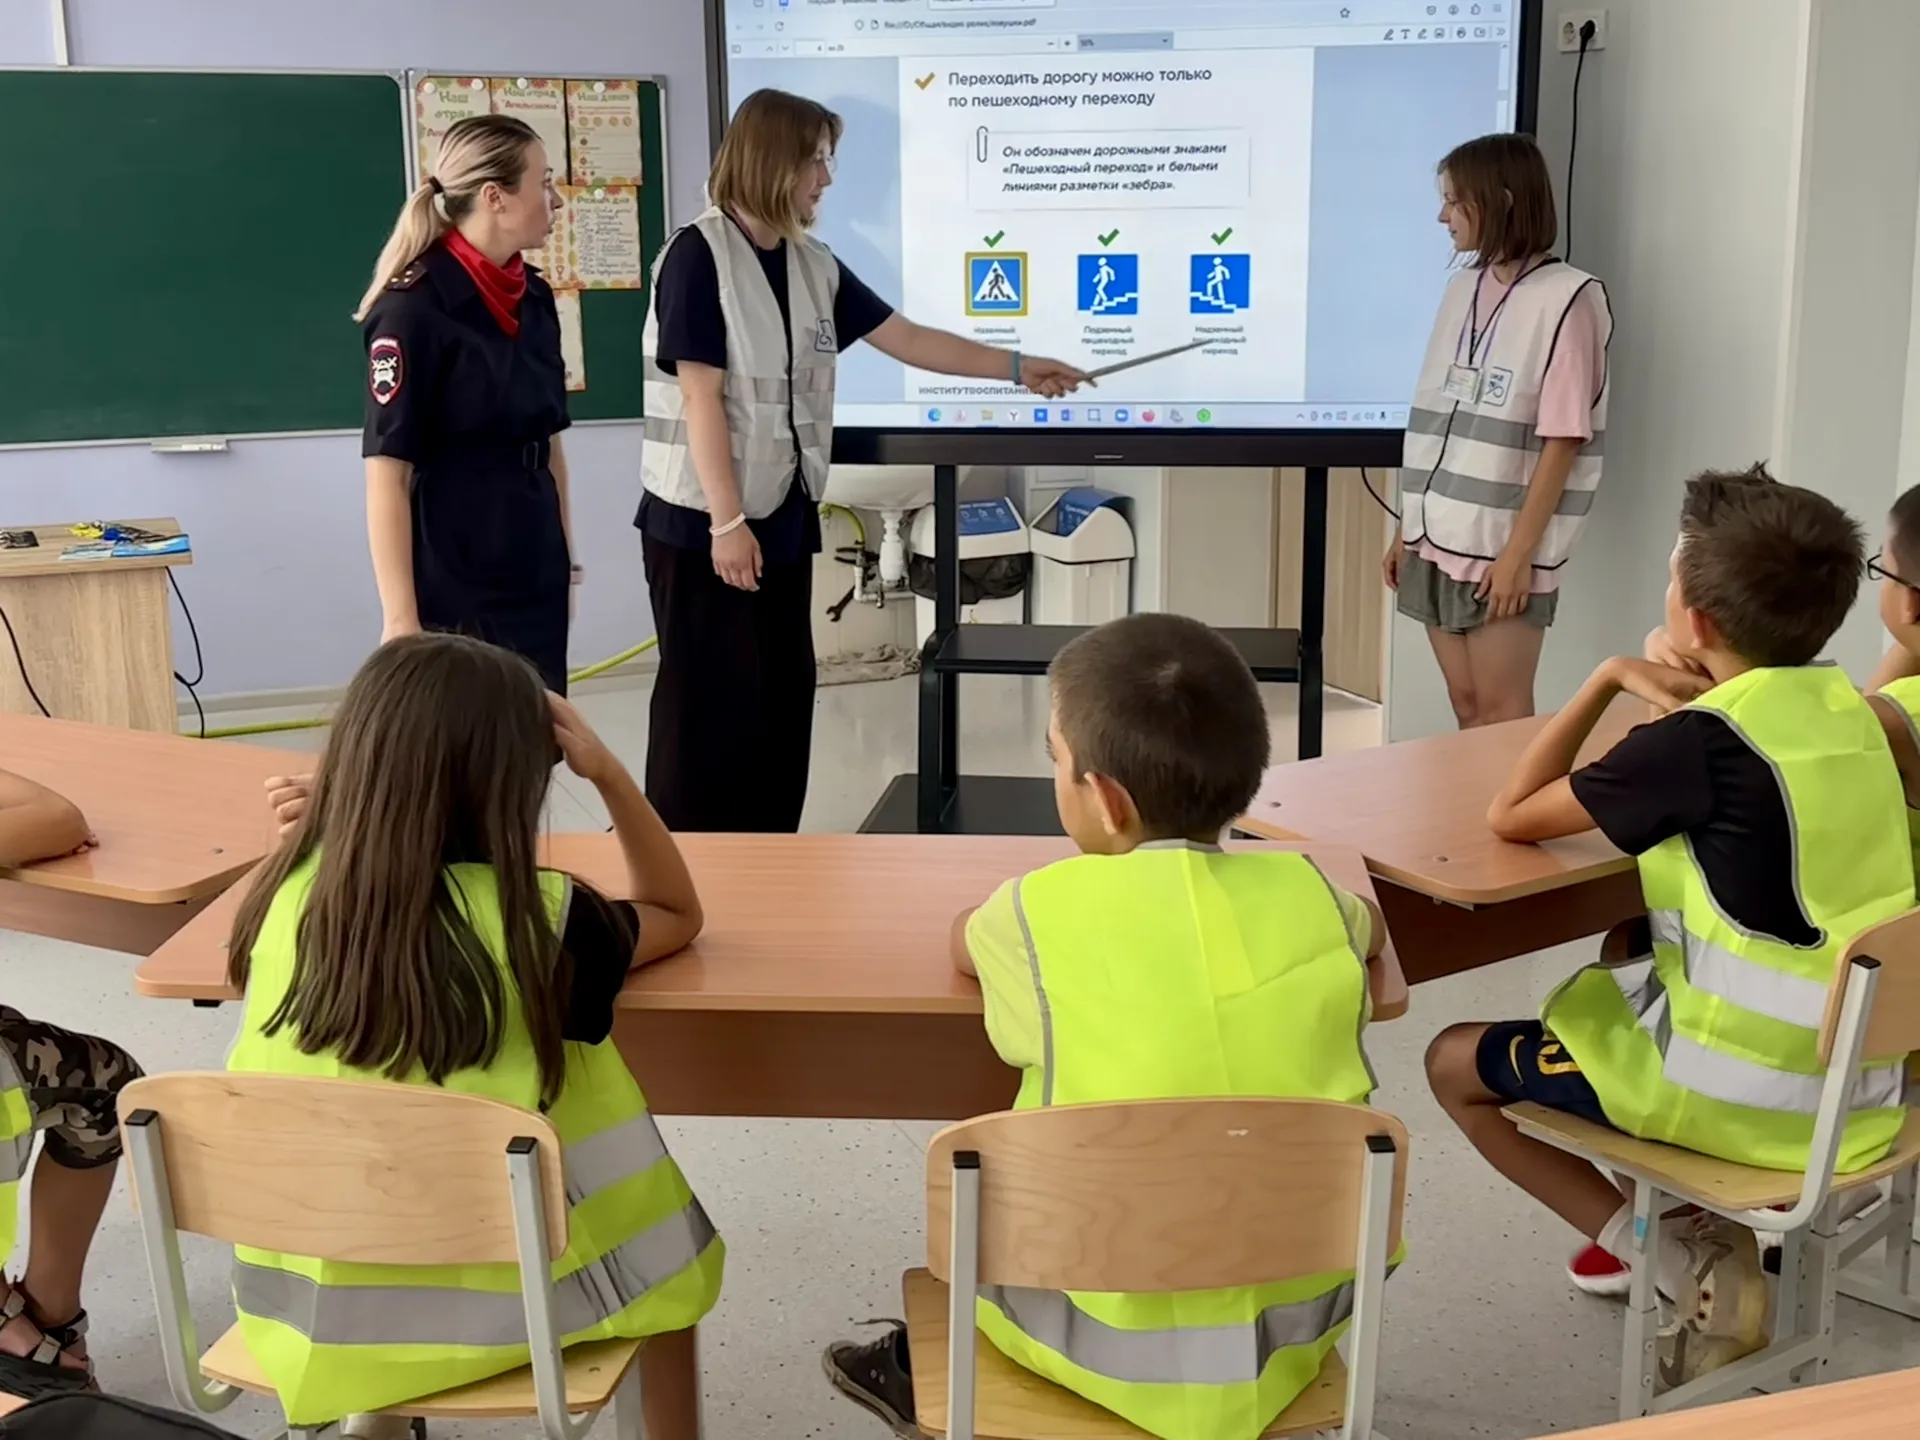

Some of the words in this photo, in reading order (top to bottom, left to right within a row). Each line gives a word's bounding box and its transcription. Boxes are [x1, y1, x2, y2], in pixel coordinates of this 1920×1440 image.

[948, 72, 1038, 87] Переходить
[1043, 71, 1098, 86] дорогу
[1102, 70, 1154, 82] можно
[1159, 69, 1212, 81] только
[949, 96, 967, 107] по
[972, 94, 1077, 107] пешеходному
[1082, 92, 1155, 106] переходу
[1002, 146, 1021, 157] Он
[1024, 146, 1091, 157] обозначен
[1093, 145, 1170, 157] дорожными
[1173, 144, 1227, 155] знаками
[1002, 162, 1091, 175] «Пешеходный
[1093, 162, 1153, 174] переход»
[1156, 163, 1165, 172] и
[1168, 161, 1218, 172] белыми
[1002, 181, 1057, 192] линиями
[1059, 180, 1118, 192] разметки
[1121, 179, 1175, 191] «зебра».
[1084, 325, 1132, 333] Подземный
[1195, 325, 1243, 333] Надземный
[1081, 336, 1134, 344] пешеходный
[1091, 348, 1128, 356] переход
